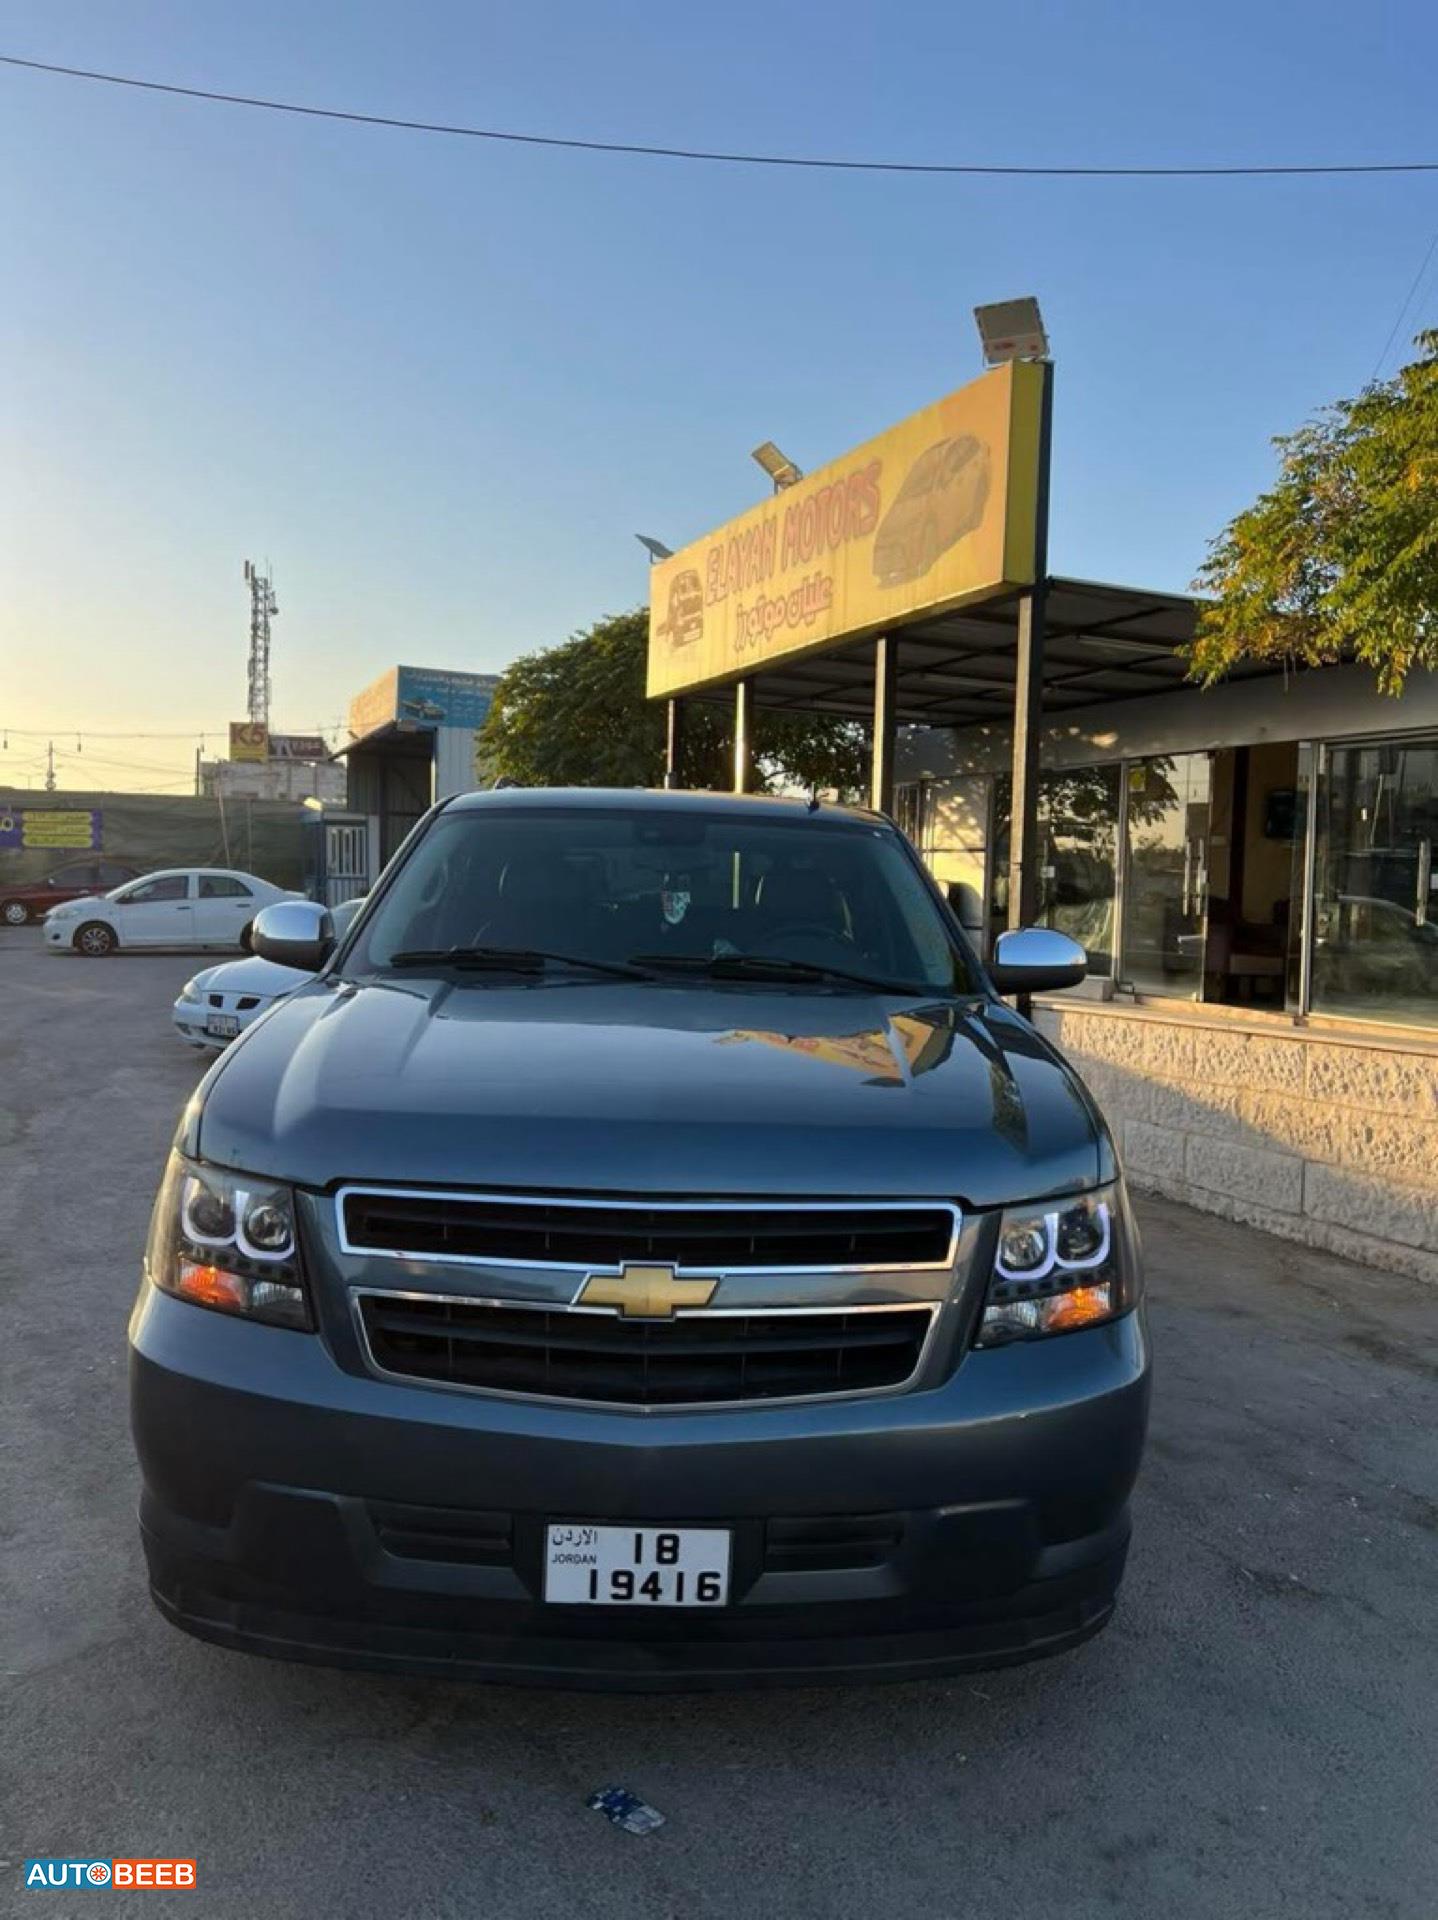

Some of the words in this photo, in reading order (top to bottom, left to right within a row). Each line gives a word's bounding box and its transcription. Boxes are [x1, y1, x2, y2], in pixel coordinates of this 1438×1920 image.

[705, 515, 777, 607] ELAYAN
[781, 456, 882, 573] MOTORS
[787, 571, 833, 628] عليان
[552, 1553, 597, 1564] JORDAN
[634, 1532, 680, 1565] 18
[589, 1569, 721, 1602] 19416
